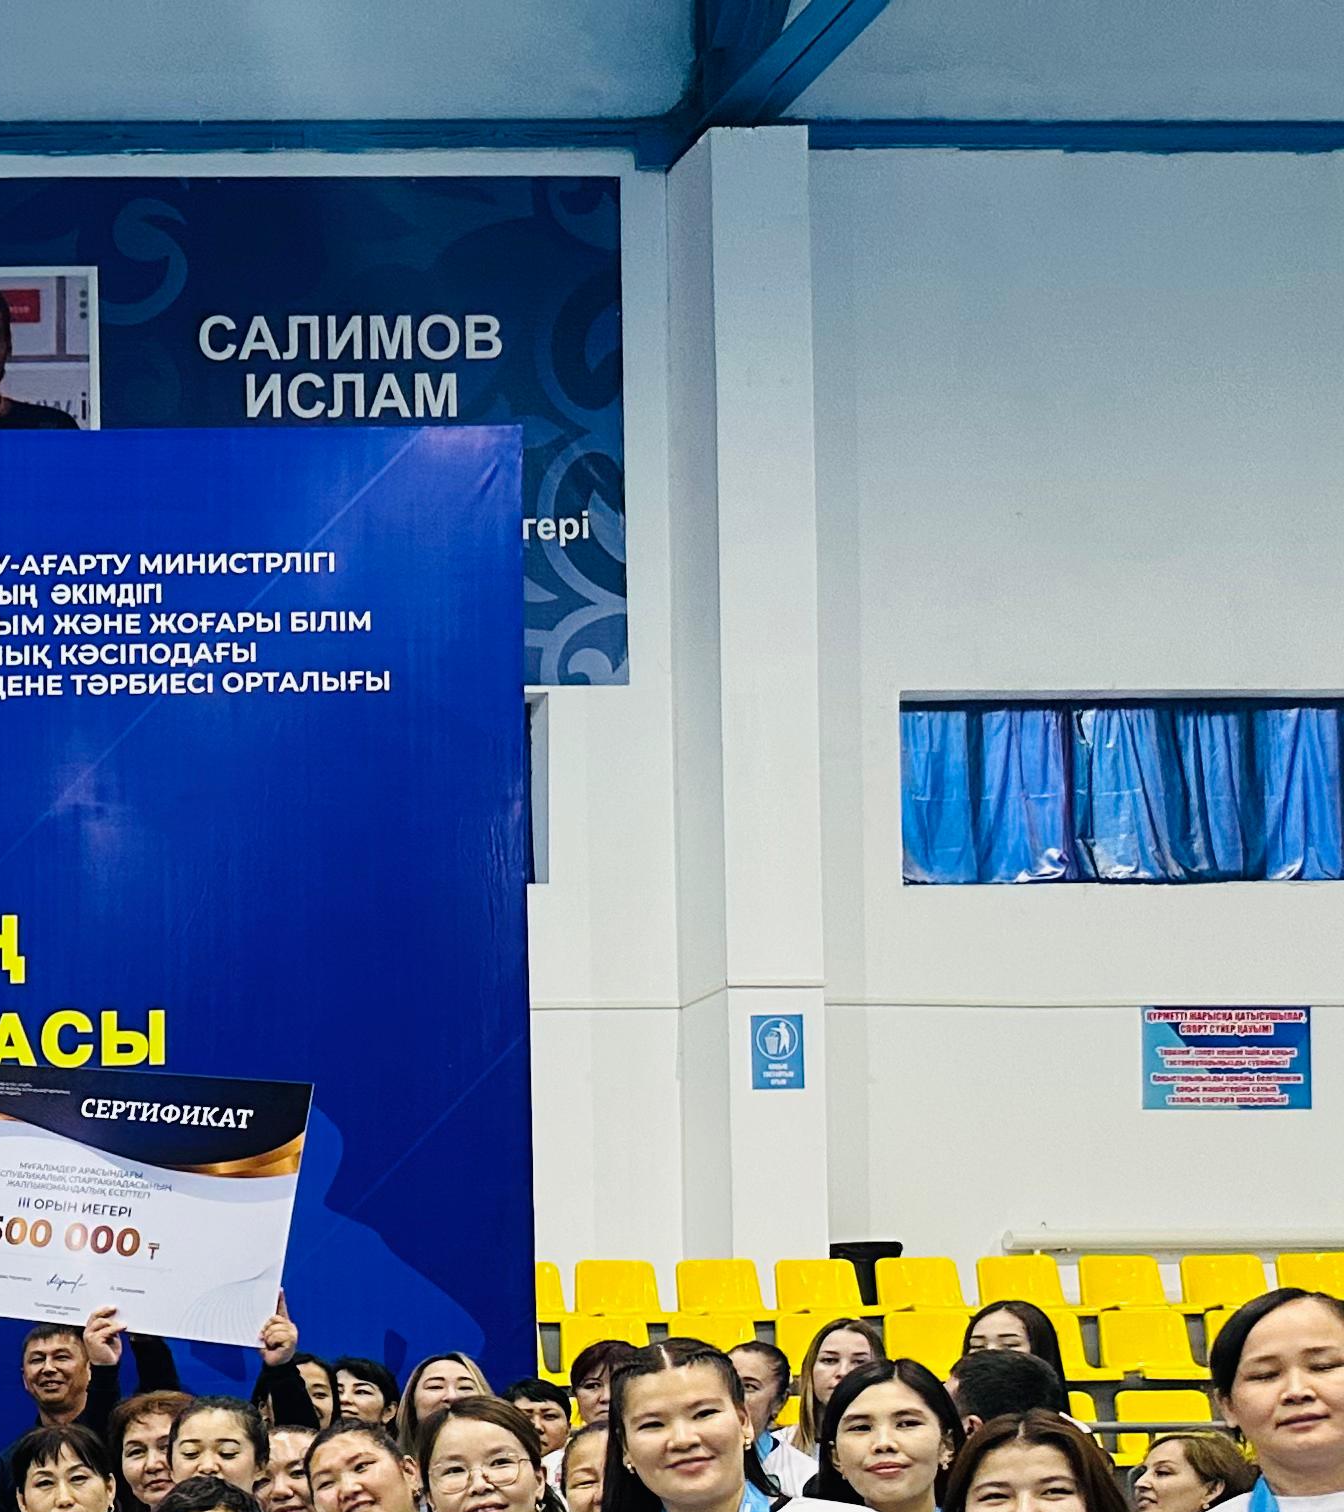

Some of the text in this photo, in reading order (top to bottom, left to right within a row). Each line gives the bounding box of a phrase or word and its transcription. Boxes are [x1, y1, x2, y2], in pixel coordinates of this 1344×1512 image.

[198, 315, 503, 361] САЛИМОВ
[245, 373, 459, 419] ИСЛАМ
[523, 512, 591, 544] гері
[140, 552, 336, 574] МИНИСТРЛІГІ
[50, 583, 163, 607] ӘКІМДІГІ
[53, 613, 141, 635] ЖӘНЕ
[149, 611, 281, 634] ЖОҒАРЫ
[290, 610, 372, 633] БІЛІМ
[60, 642, 257, 667] КӘСІПОДАҒЫ
[70, 672, 213, 695] ТӘРБИЕСІ
[221, 670, 391, 693] ОРТАЛЫҒЫ
[80, 1098, 254, 1129] СЕРТИФИКАТ
[34, 1199, 77, 1212] ОРЫН
[81, 1204, 132, 1218] ИЕГЕРІ
[64, 1222, 141, 1257] 000
